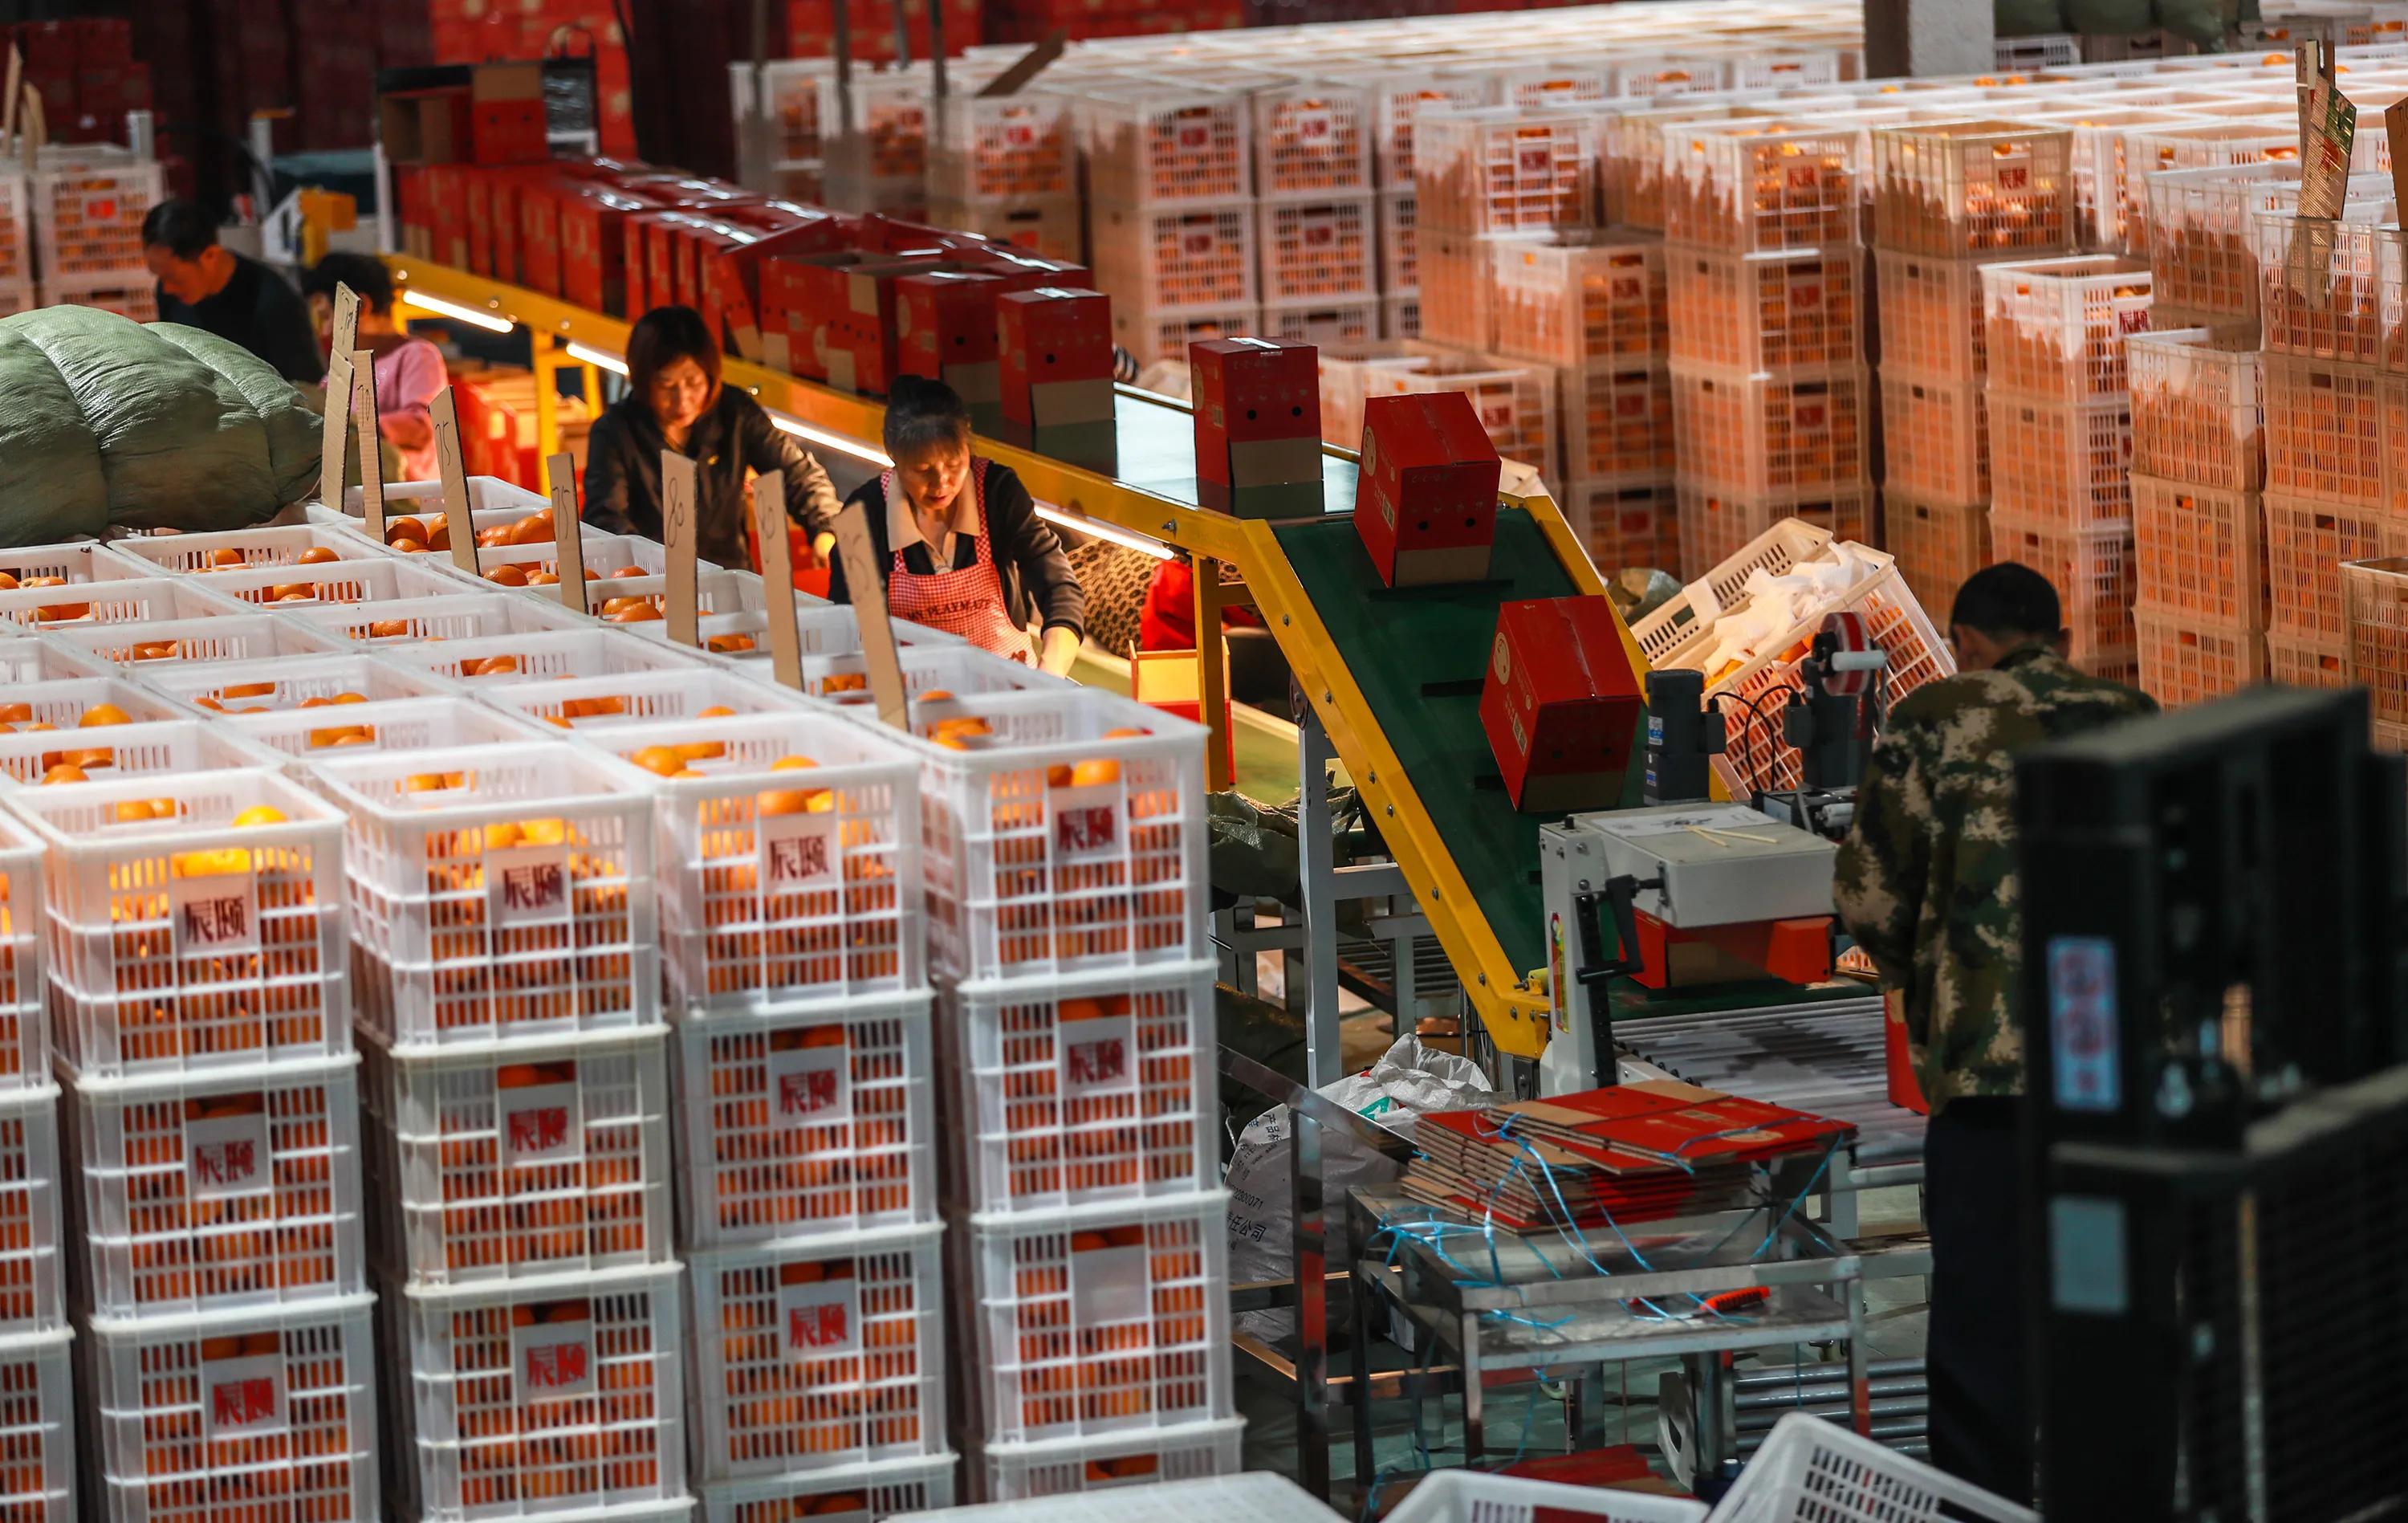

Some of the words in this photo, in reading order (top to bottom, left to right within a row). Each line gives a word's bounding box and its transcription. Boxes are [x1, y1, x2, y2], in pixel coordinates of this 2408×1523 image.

[357, 385, 370, 427] 70
[435, 420, 450, 474] 75
[551, 485, 570, 540] 75
[184, 894, 246, 944] 辰颐
